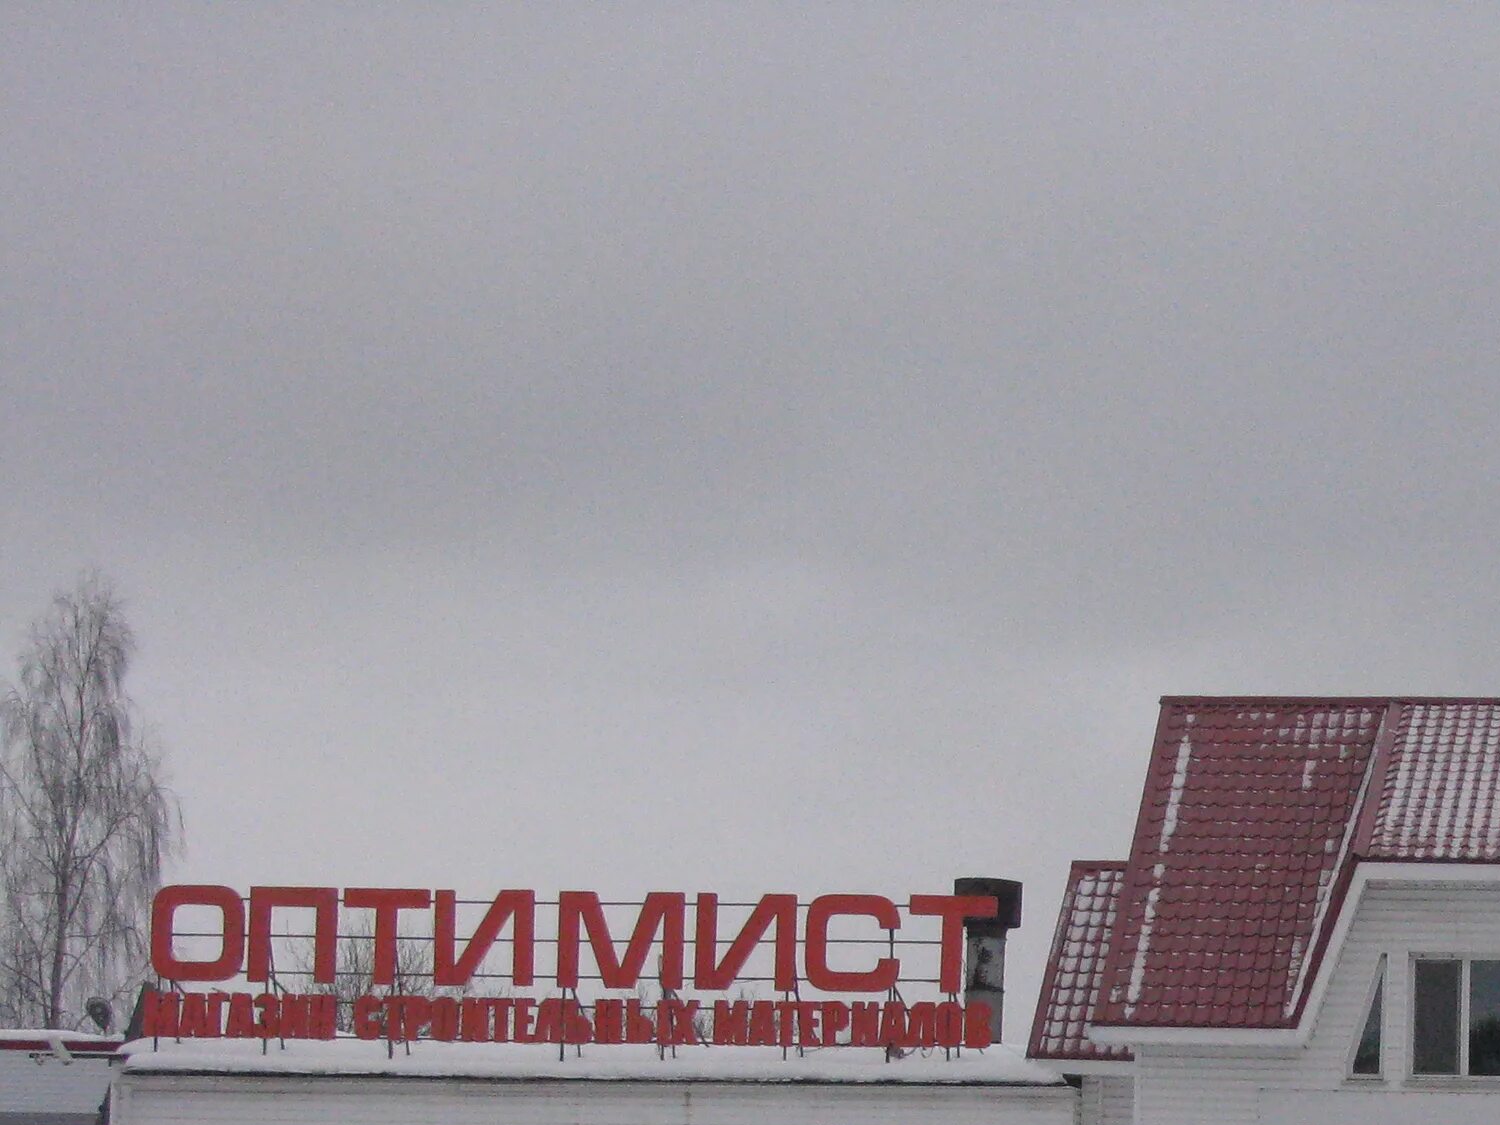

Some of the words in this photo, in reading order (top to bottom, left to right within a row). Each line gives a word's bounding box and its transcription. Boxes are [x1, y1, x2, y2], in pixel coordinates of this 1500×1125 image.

[150, 884, 998, 993] ОПТИМИСТ
[144, 991, 337, 1039] МАГАЗИН
[353, 993, 701, 1045] СТРОИТЕЛЬНЫХ
[713, 999, 994, 1048] МАТЕРИАЛОВ
